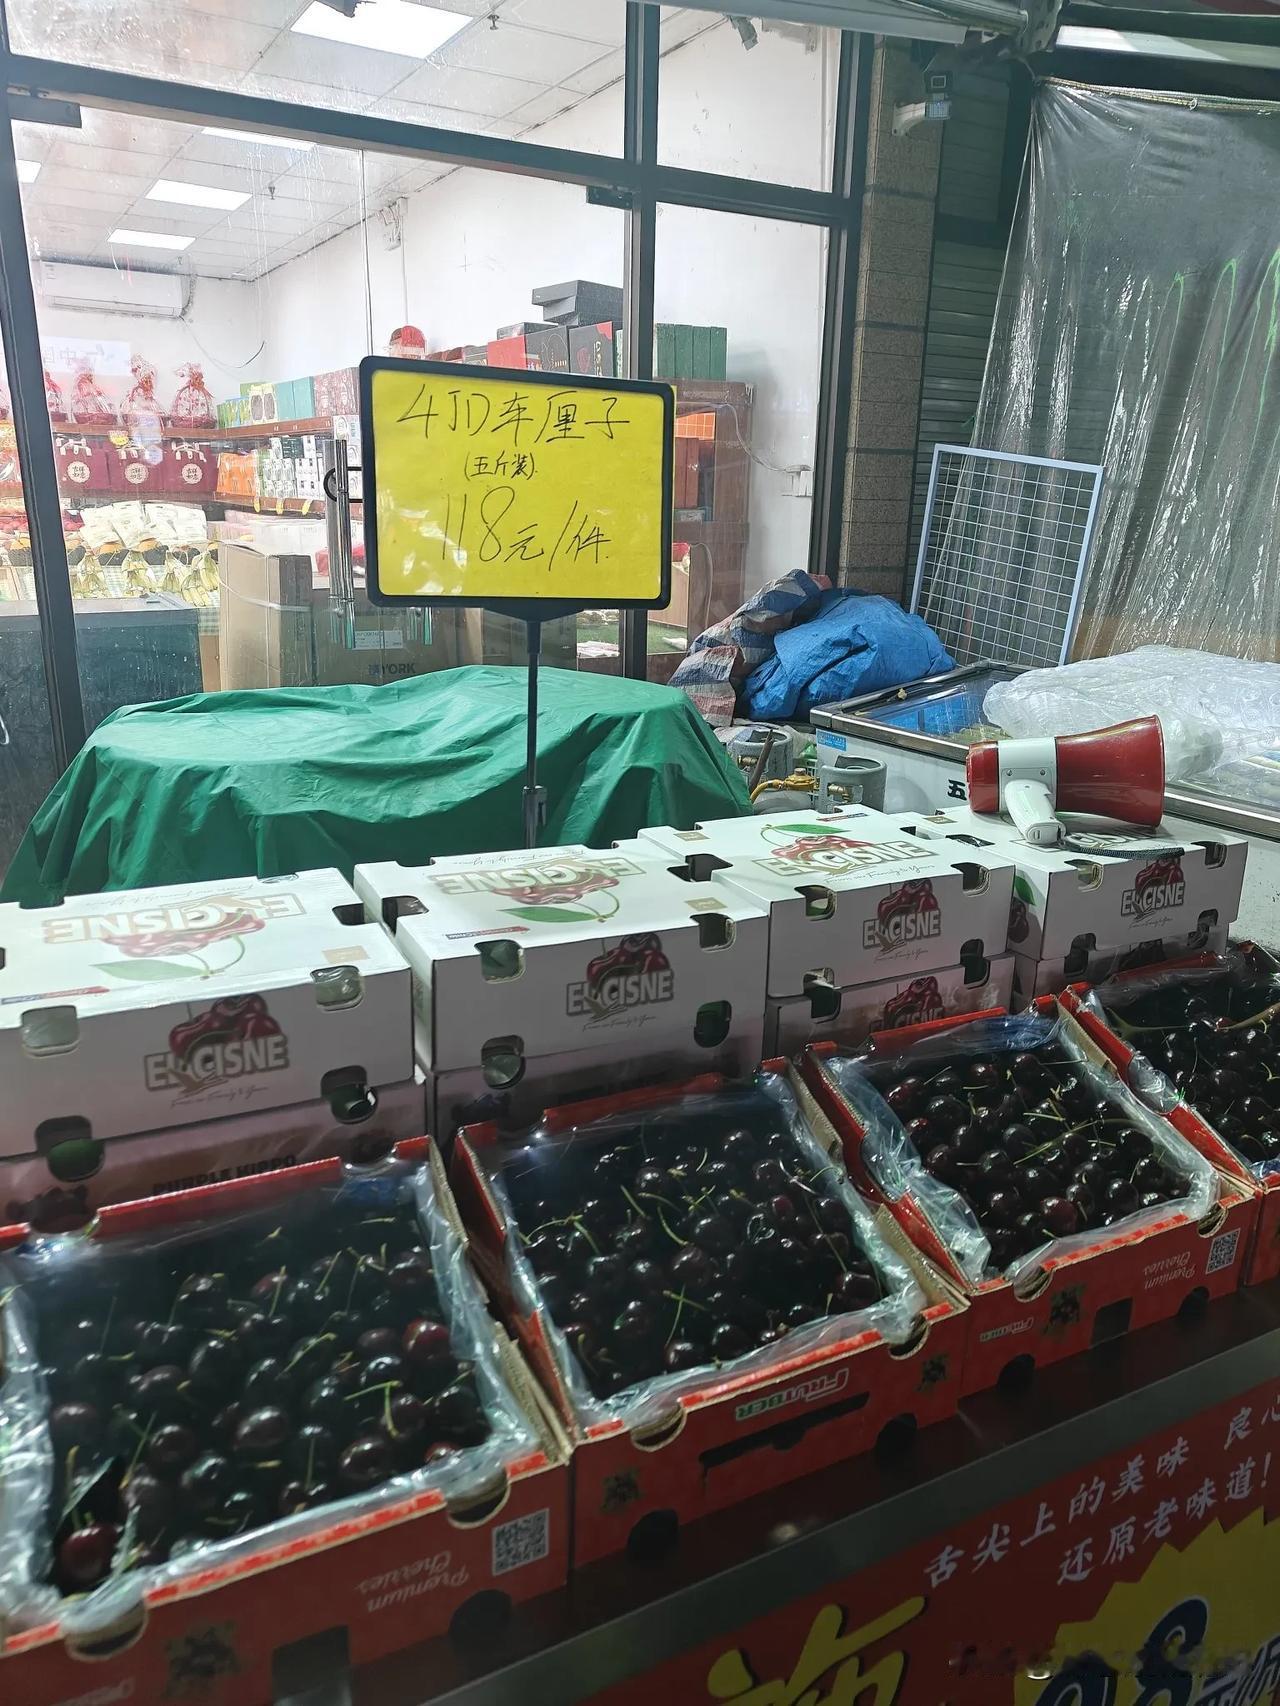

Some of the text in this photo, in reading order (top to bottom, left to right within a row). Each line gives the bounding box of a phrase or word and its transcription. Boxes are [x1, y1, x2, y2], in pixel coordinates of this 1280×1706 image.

[812, 841, 940, 869] CISNE
[428, 864, 578, 894] CISNE
[1142, 880, 1186, 911] CISNE
[40, 904, 224, 944] CISNE
[887, 908, 941, 944] CISNE
[600, 968, 675, 1008] CISNE
[192, 1033, 290, 1080] CISNE
[925, 1436, 1189, 1589] 舌尖上的美味
[1057, 1451, 1272, 1586] 还原老味道!
[353, 1549, 452, 1595] Cherries
[367, 1564, 470, 1613] Premium
